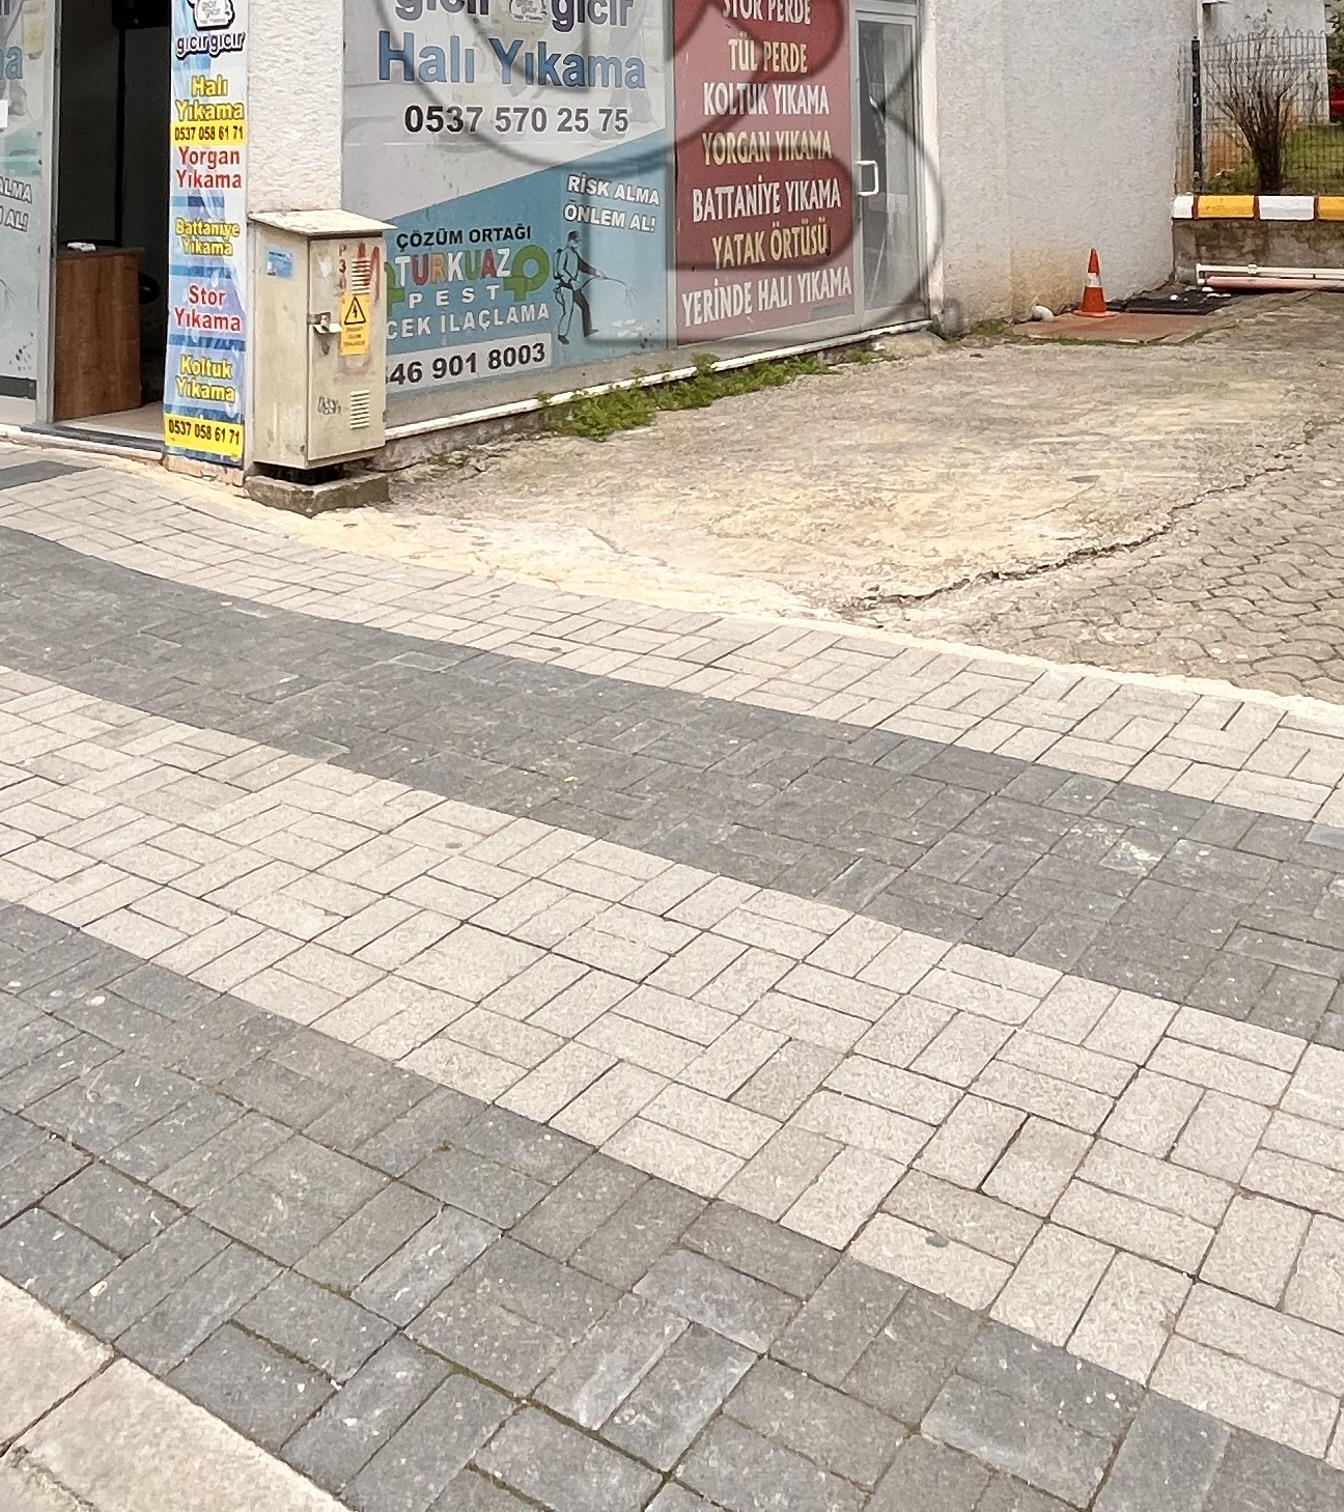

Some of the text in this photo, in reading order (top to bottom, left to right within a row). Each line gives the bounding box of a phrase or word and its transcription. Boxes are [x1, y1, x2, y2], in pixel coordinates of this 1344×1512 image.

[379, 30, 646, 89] Halı Yıkama
[728, 31, 808, 74] TÜL PERDE
[190, 74, 229, 97] Halı
[703, 82, 830, 115] KOLTUK YIKAMA
[175, 99, 245, 121] Yıkama
[405, 105, 629, 133] 0537 570 25 75
[174, 125, 243, 141] 0537 058 61 71
[178, 146, 240, 169] Yorgan
[702, 130, 833, 166] YORGAN YIKAMA
[176, 170, 242, 189] Yıkama
[567, 172, 660, 206] RİSK ALMA
[692, 174, 842, 223] BATTANİYE YIKAMA
[4, 209, 29, 232] AL!
[564, 200, 657, 233] ÖNLEM AL!
[181, 236, 234, 256] Yıkama
[396, 223, 532, 252] ÇÖZÜM ORTAĞI
[712, 217, 828, 270] YATAK ÖRTÜSÜ
[394, 247, 511, 287] TURKUAZ
[188, 285, 226, 306] Stor
[409, 284, 501, 309] PEST
[682, 266, 853, 328] YERİNDE HALI YIKAMA
[174, 307, 241, 332] Yıkama
[386, 316, 432, 340] CEK
[440, 303, 549, 334] İLAÇLAMA
[180, 354, 233, 380] Koltuk
[386, 343, 546, 385] 46 901 8003
[175, 375, 235, 403] Yıkama
[168, 419, 240, 446] 0537 058 61 71
